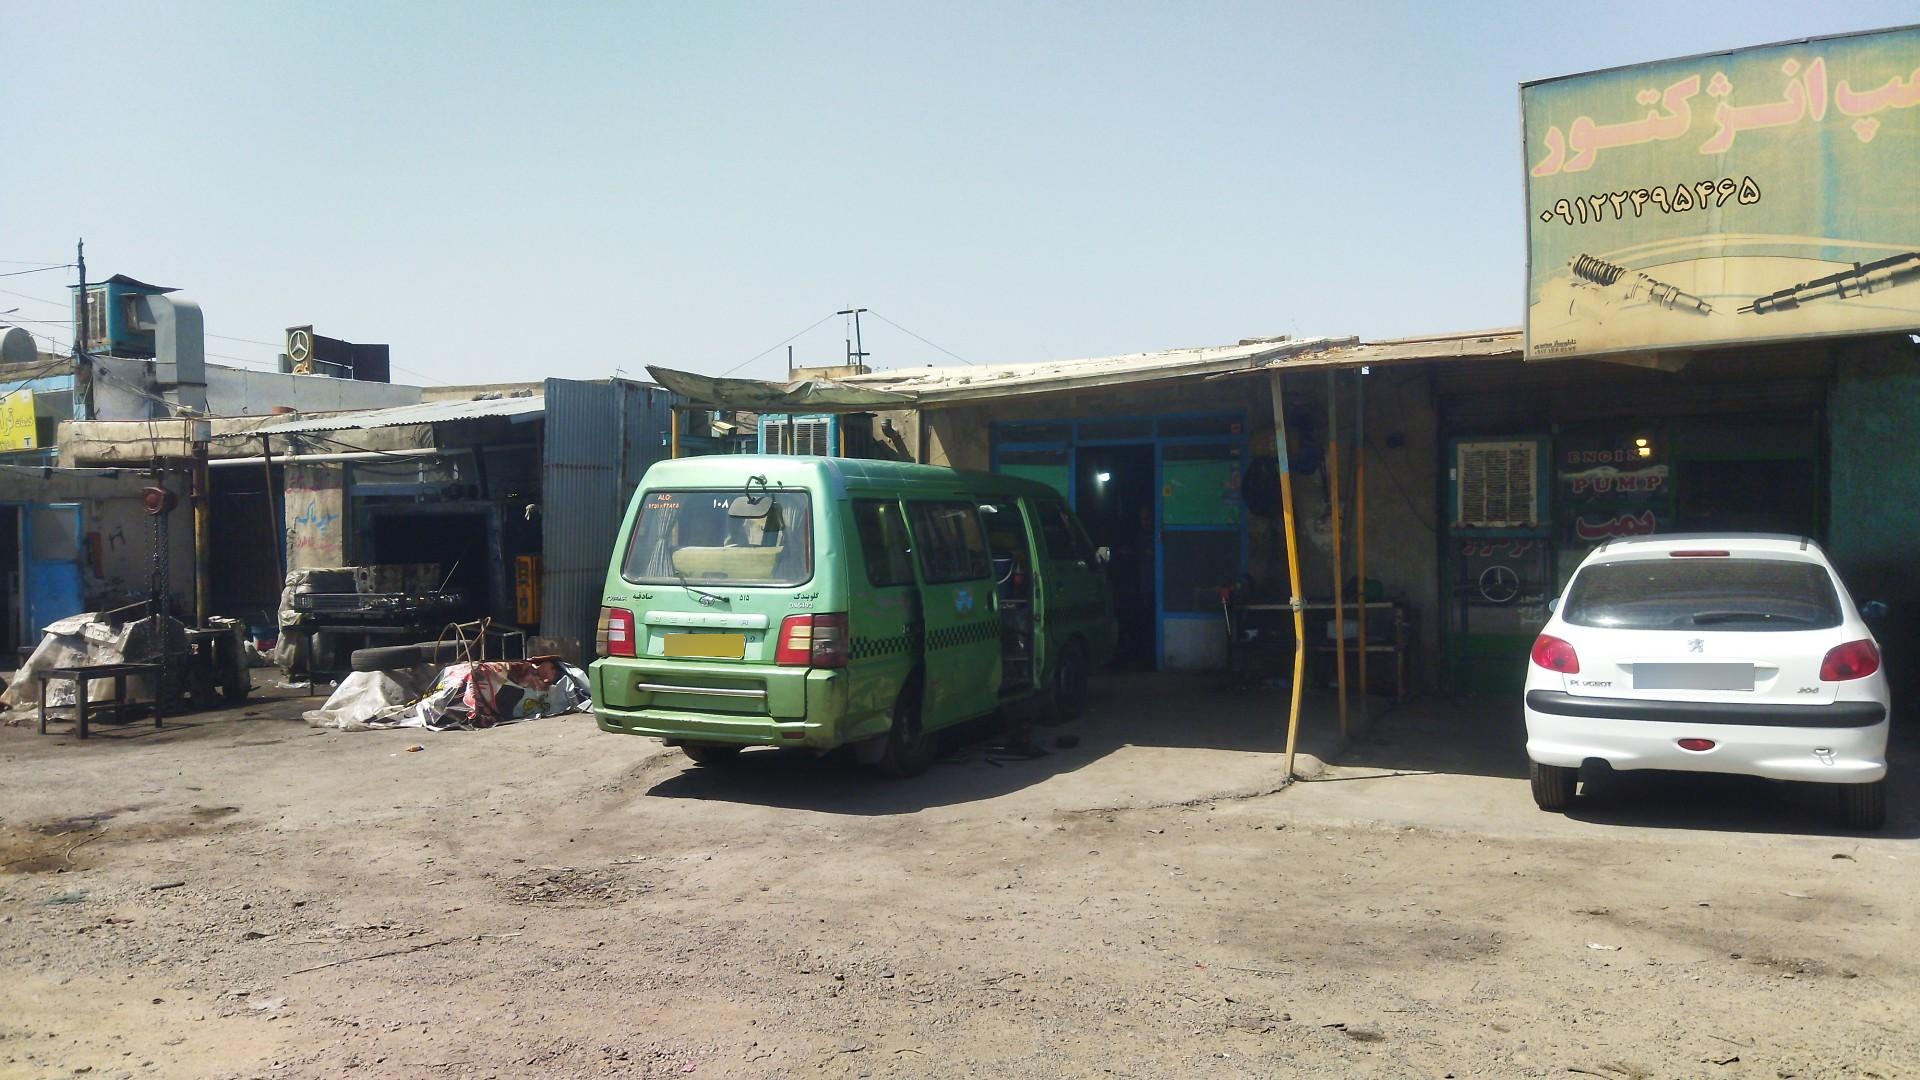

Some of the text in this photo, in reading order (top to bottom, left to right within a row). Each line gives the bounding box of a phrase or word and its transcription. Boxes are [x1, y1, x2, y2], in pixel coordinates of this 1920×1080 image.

[1540, 176, 1761, 225] ۰۹۱۲۲۴۹۵۴۶۵
[1567, 450, 1646, 464] ENGIN
[1571, 475, 1662, 494] PUMP
